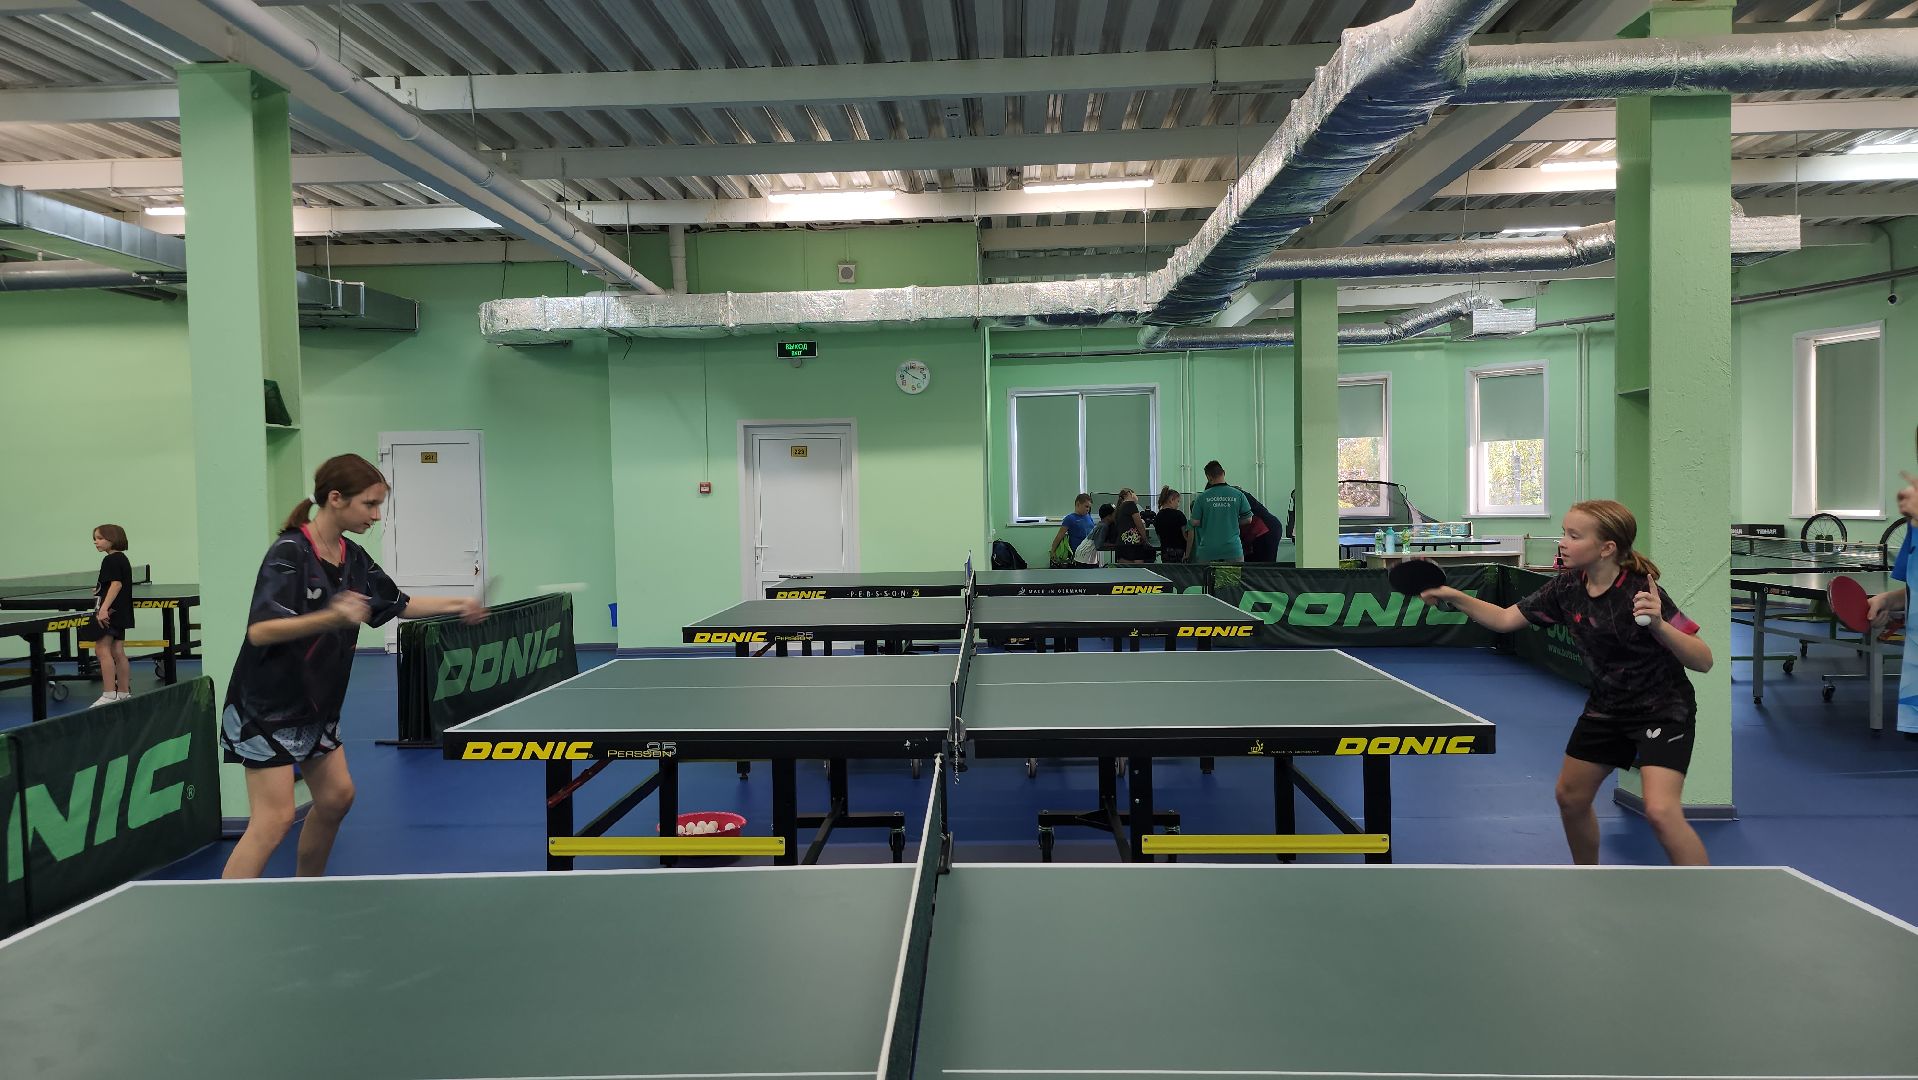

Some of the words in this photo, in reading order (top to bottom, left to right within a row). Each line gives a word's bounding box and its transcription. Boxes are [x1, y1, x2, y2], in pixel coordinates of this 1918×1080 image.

[776, 591, 826, 599] DONIC
[1112, 585, 1164, 594] DONIC
[47, 616, 91, 631] DONIC
[693, 631, 767, 643] DONIC
[1177, 626, 1254, 637] DONIC
[433, 622, 561, 701] DONIC
[462, 741, 593, 760] DONIC
[1335, 735, 1476, 756] DONIC
[8, 732, 192, 884] NIC
